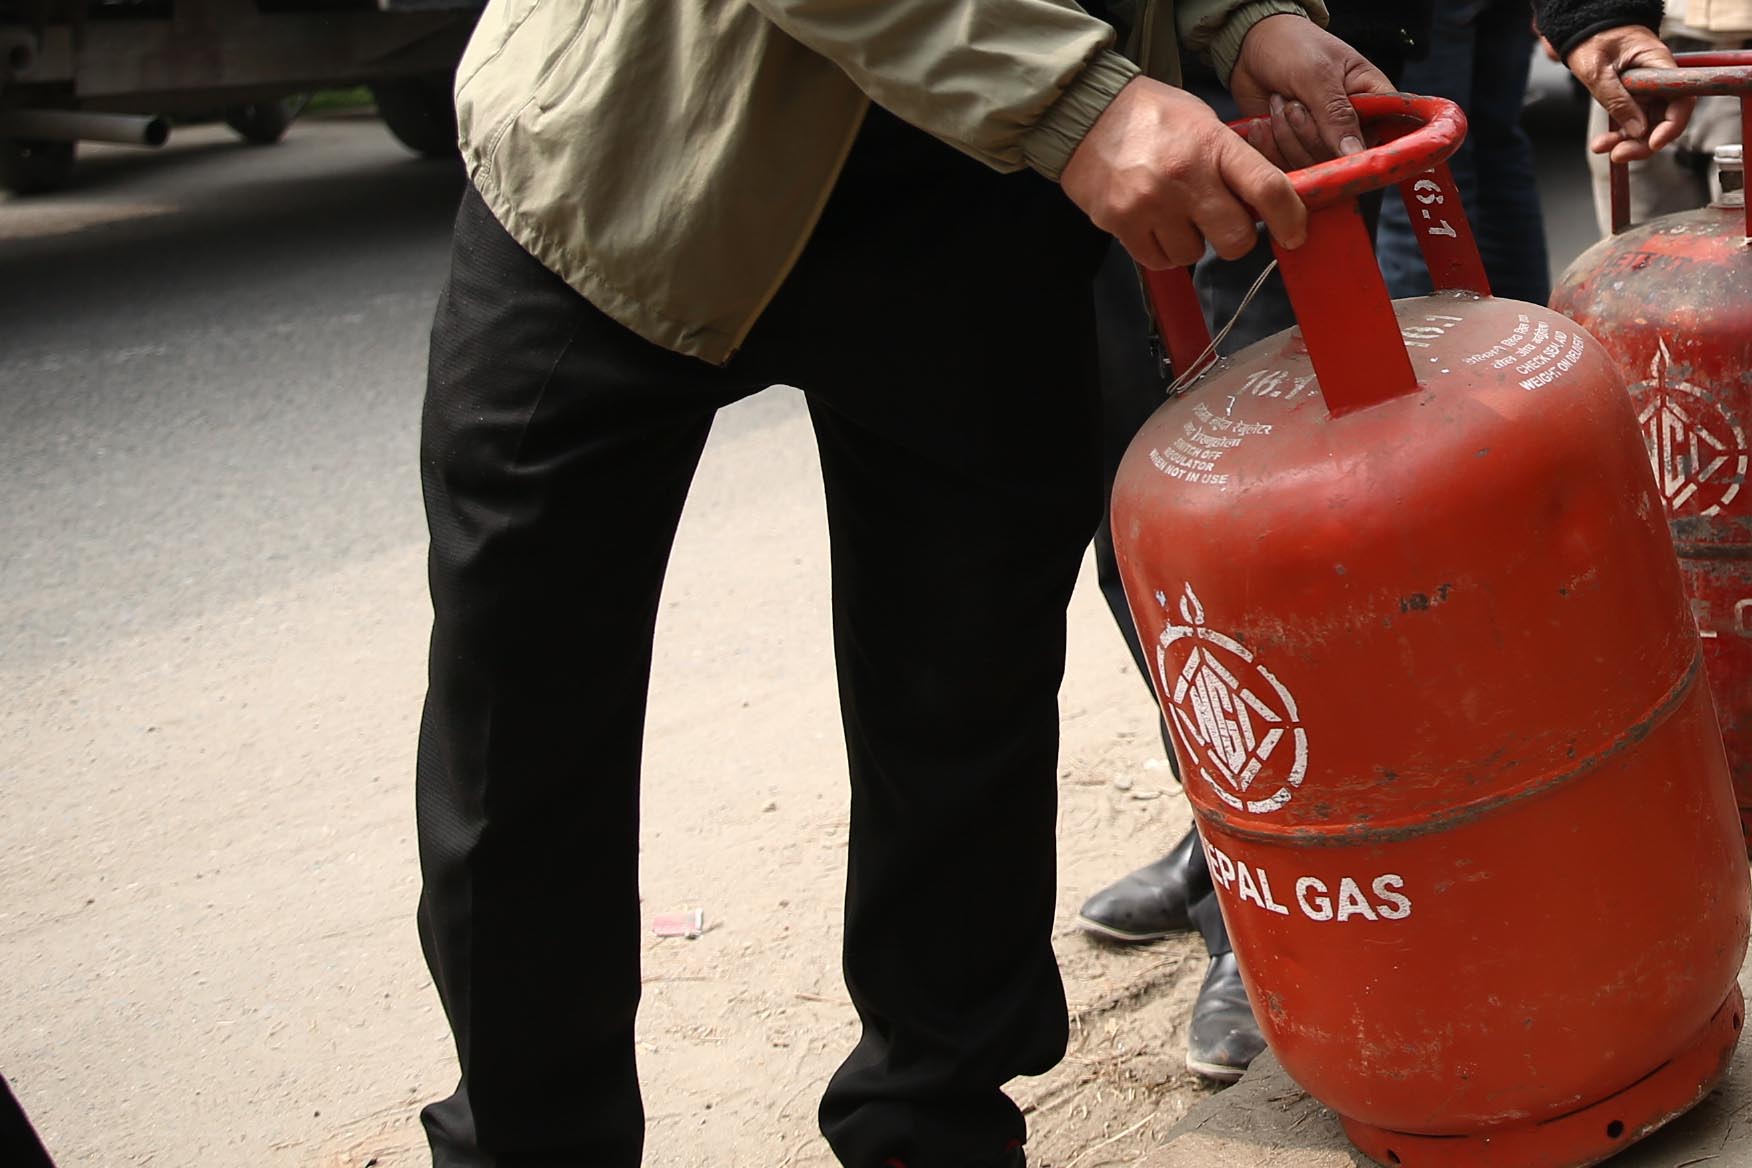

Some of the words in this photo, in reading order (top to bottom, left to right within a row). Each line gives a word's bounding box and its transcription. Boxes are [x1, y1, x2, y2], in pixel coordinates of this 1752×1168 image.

[1515, 355, 1547, 375] CHECK
[1518, 367, 1562, 391] WEIGHT
[1557, 358, 1573, 373] ON
[1149, 448, 1167, 471] WHEN
[1165, 464, 1187, 480] NOT
[1185, 472, 1198, 482] IN
[1202, 474, 1230, 484] USE
[1163, 447, 1215, 472] REGULATOR
[1200, 449, 1223, 461] OFF
[1204, 838, 1290, 915] EPAL
[1295, 874, 1412, 921] GAS
